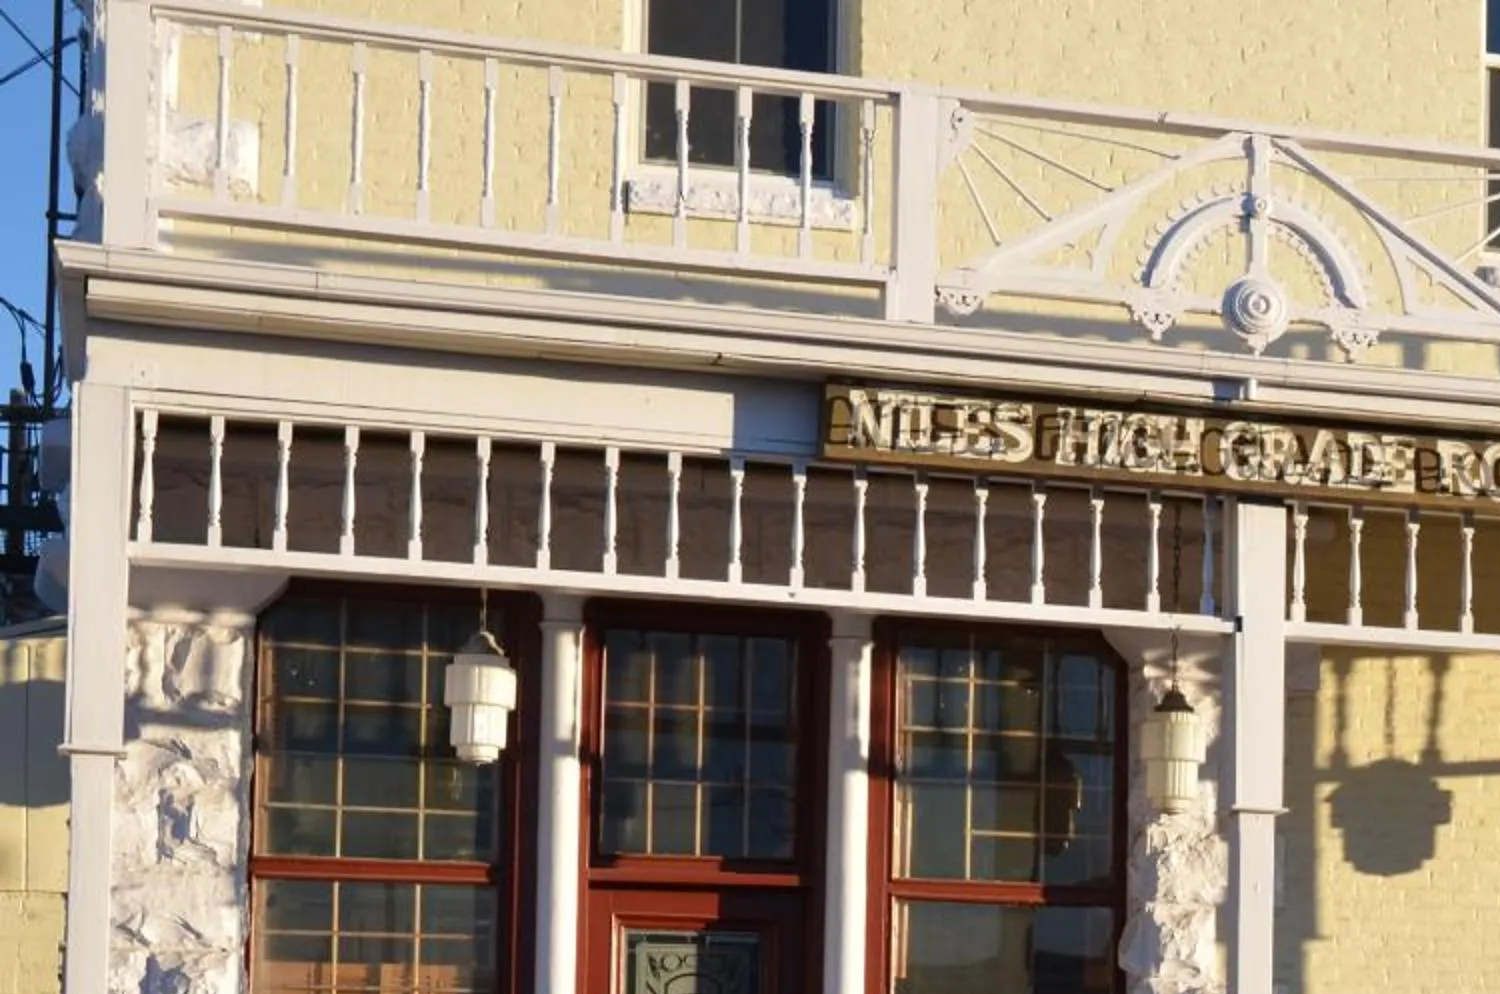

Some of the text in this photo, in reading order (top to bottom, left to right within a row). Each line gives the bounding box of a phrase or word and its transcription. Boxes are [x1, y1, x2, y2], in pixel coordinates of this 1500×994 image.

[849, 389, 1033, 463] NILES
[1055, 406, 1205, 477] HIGH
[1219, 421, 1417, 494] GRADE
